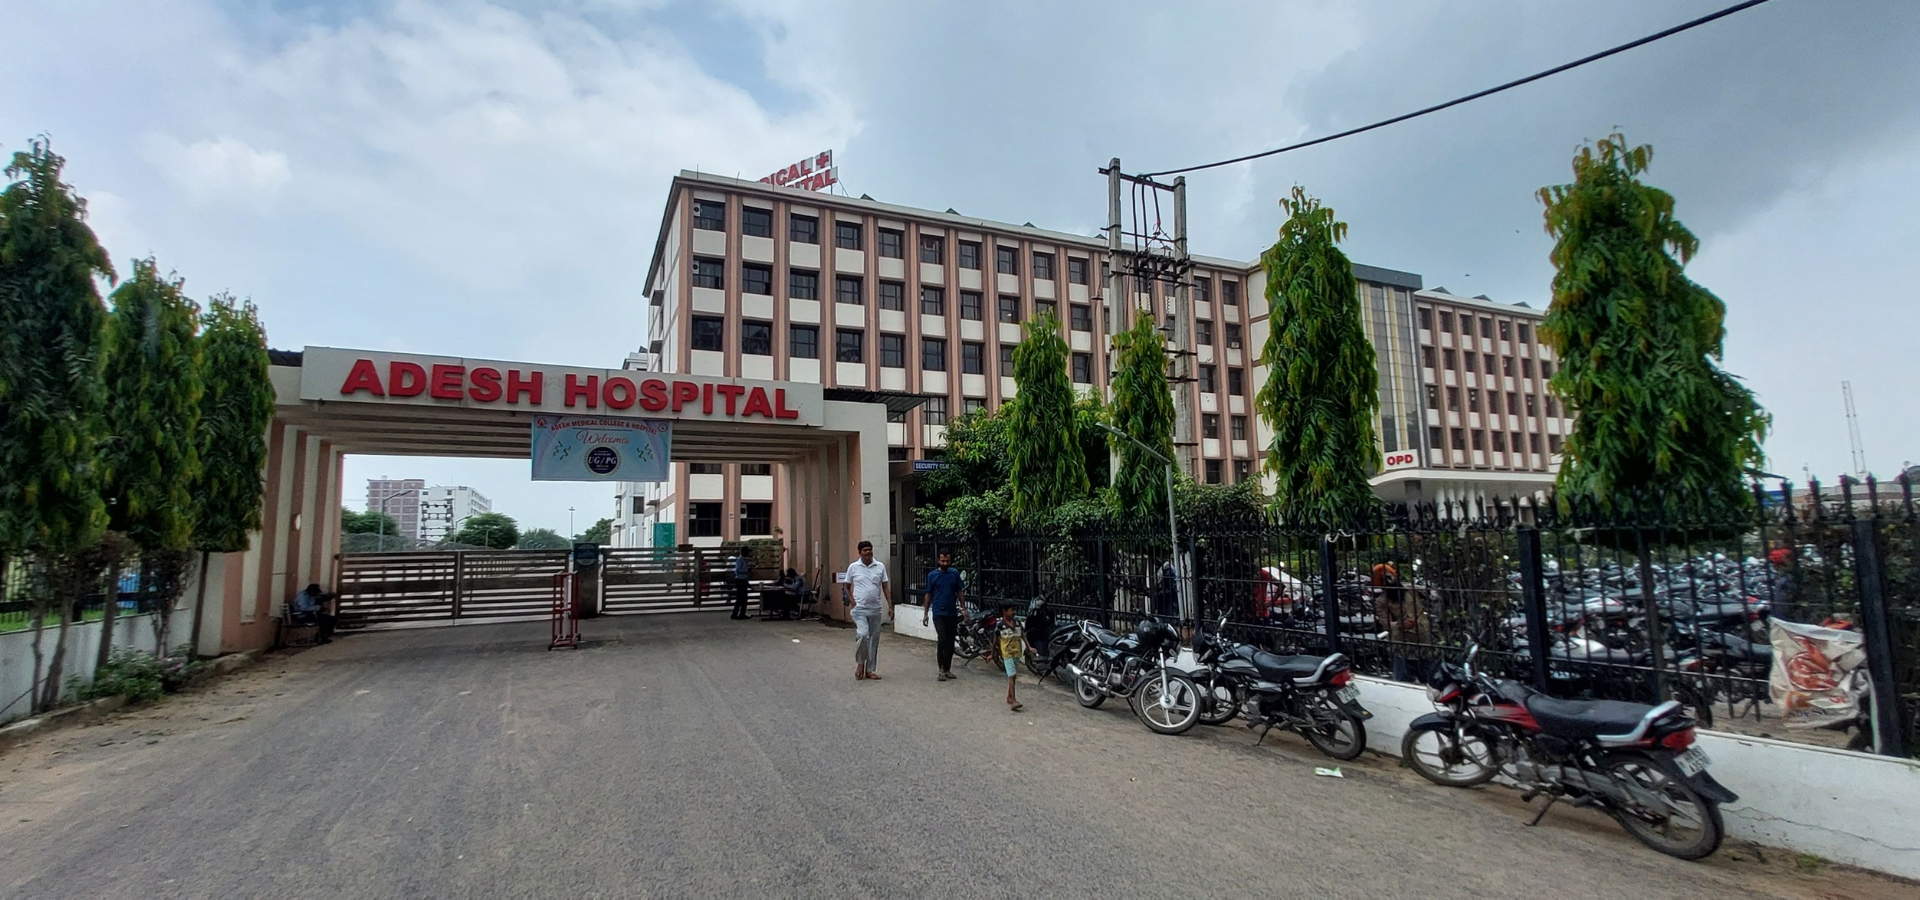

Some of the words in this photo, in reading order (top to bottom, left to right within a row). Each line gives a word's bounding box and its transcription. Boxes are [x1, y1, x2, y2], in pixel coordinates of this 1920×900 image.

[340, 359, 544, 404] ADESH
[564, 373, 799, 419] HOSPITAL
[551, 422, 571, 431] ADESH
[599, 419, 625, 428] COLLEGE
[631, 423, 658, 435] HOSPITAL
[1387, 454, 1413, 466] OPD
